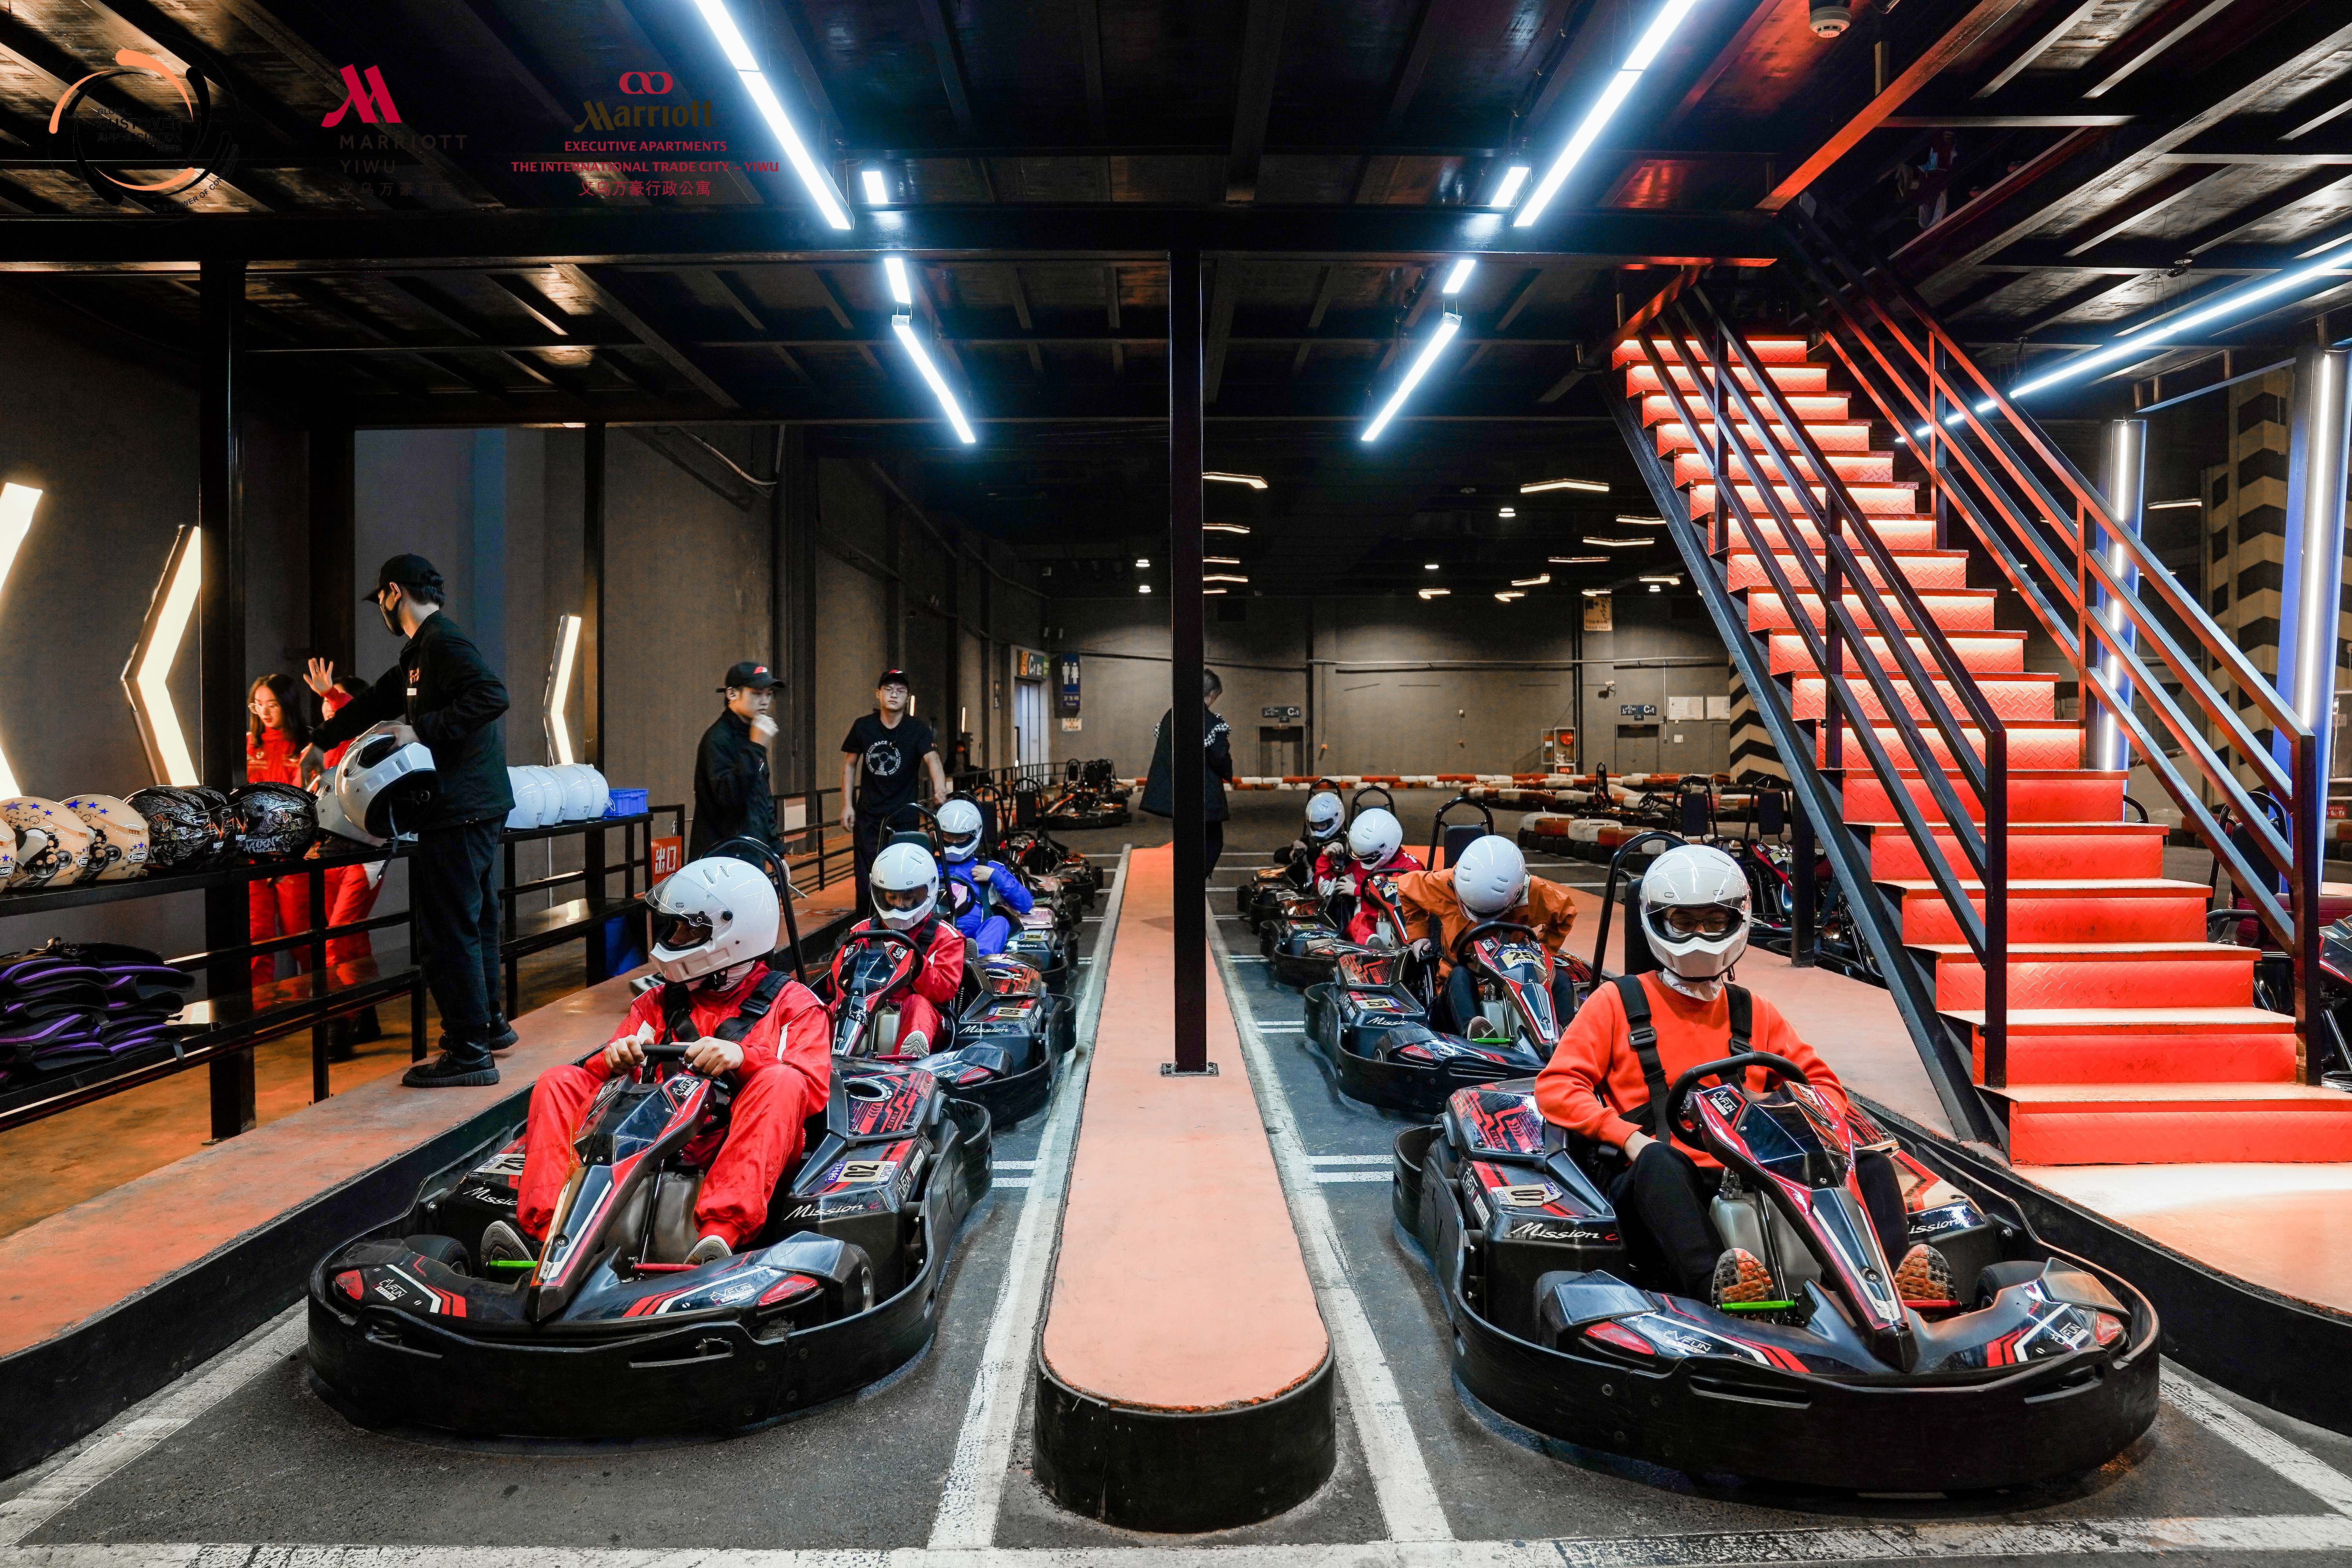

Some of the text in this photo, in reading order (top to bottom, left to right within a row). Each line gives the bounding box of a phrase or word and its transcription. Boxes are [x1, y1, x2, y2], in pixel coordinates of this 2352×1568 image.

[131, 851, 147, 860] GSB
[655, 845, 677, 875] 出口
[1509, 952, 1536, 961] 25
[1366, 1016, 1408, 1026] Missio
[958, 1025, 1009, 1034] Mission
[480, 1156, 503, 1169] SPORT
[911, 1151, 924, 1175] KARTING
[843, 1164, 880, 1178] 02
[879, 1164, 894, 1181] SPORT
[462, 1187, 518, 1205] Missio
[1495, 1191, 1511, 1204] SPORT
[784, 1203, 865, 1221] Mission
[1475, 1198, 1489, 1221] KARTING
[1510, 1222, 1600, 1239] Mission
[1908, 1219, 1961, 1234] ission
[377, 1287, 394, 1299] KARTING
